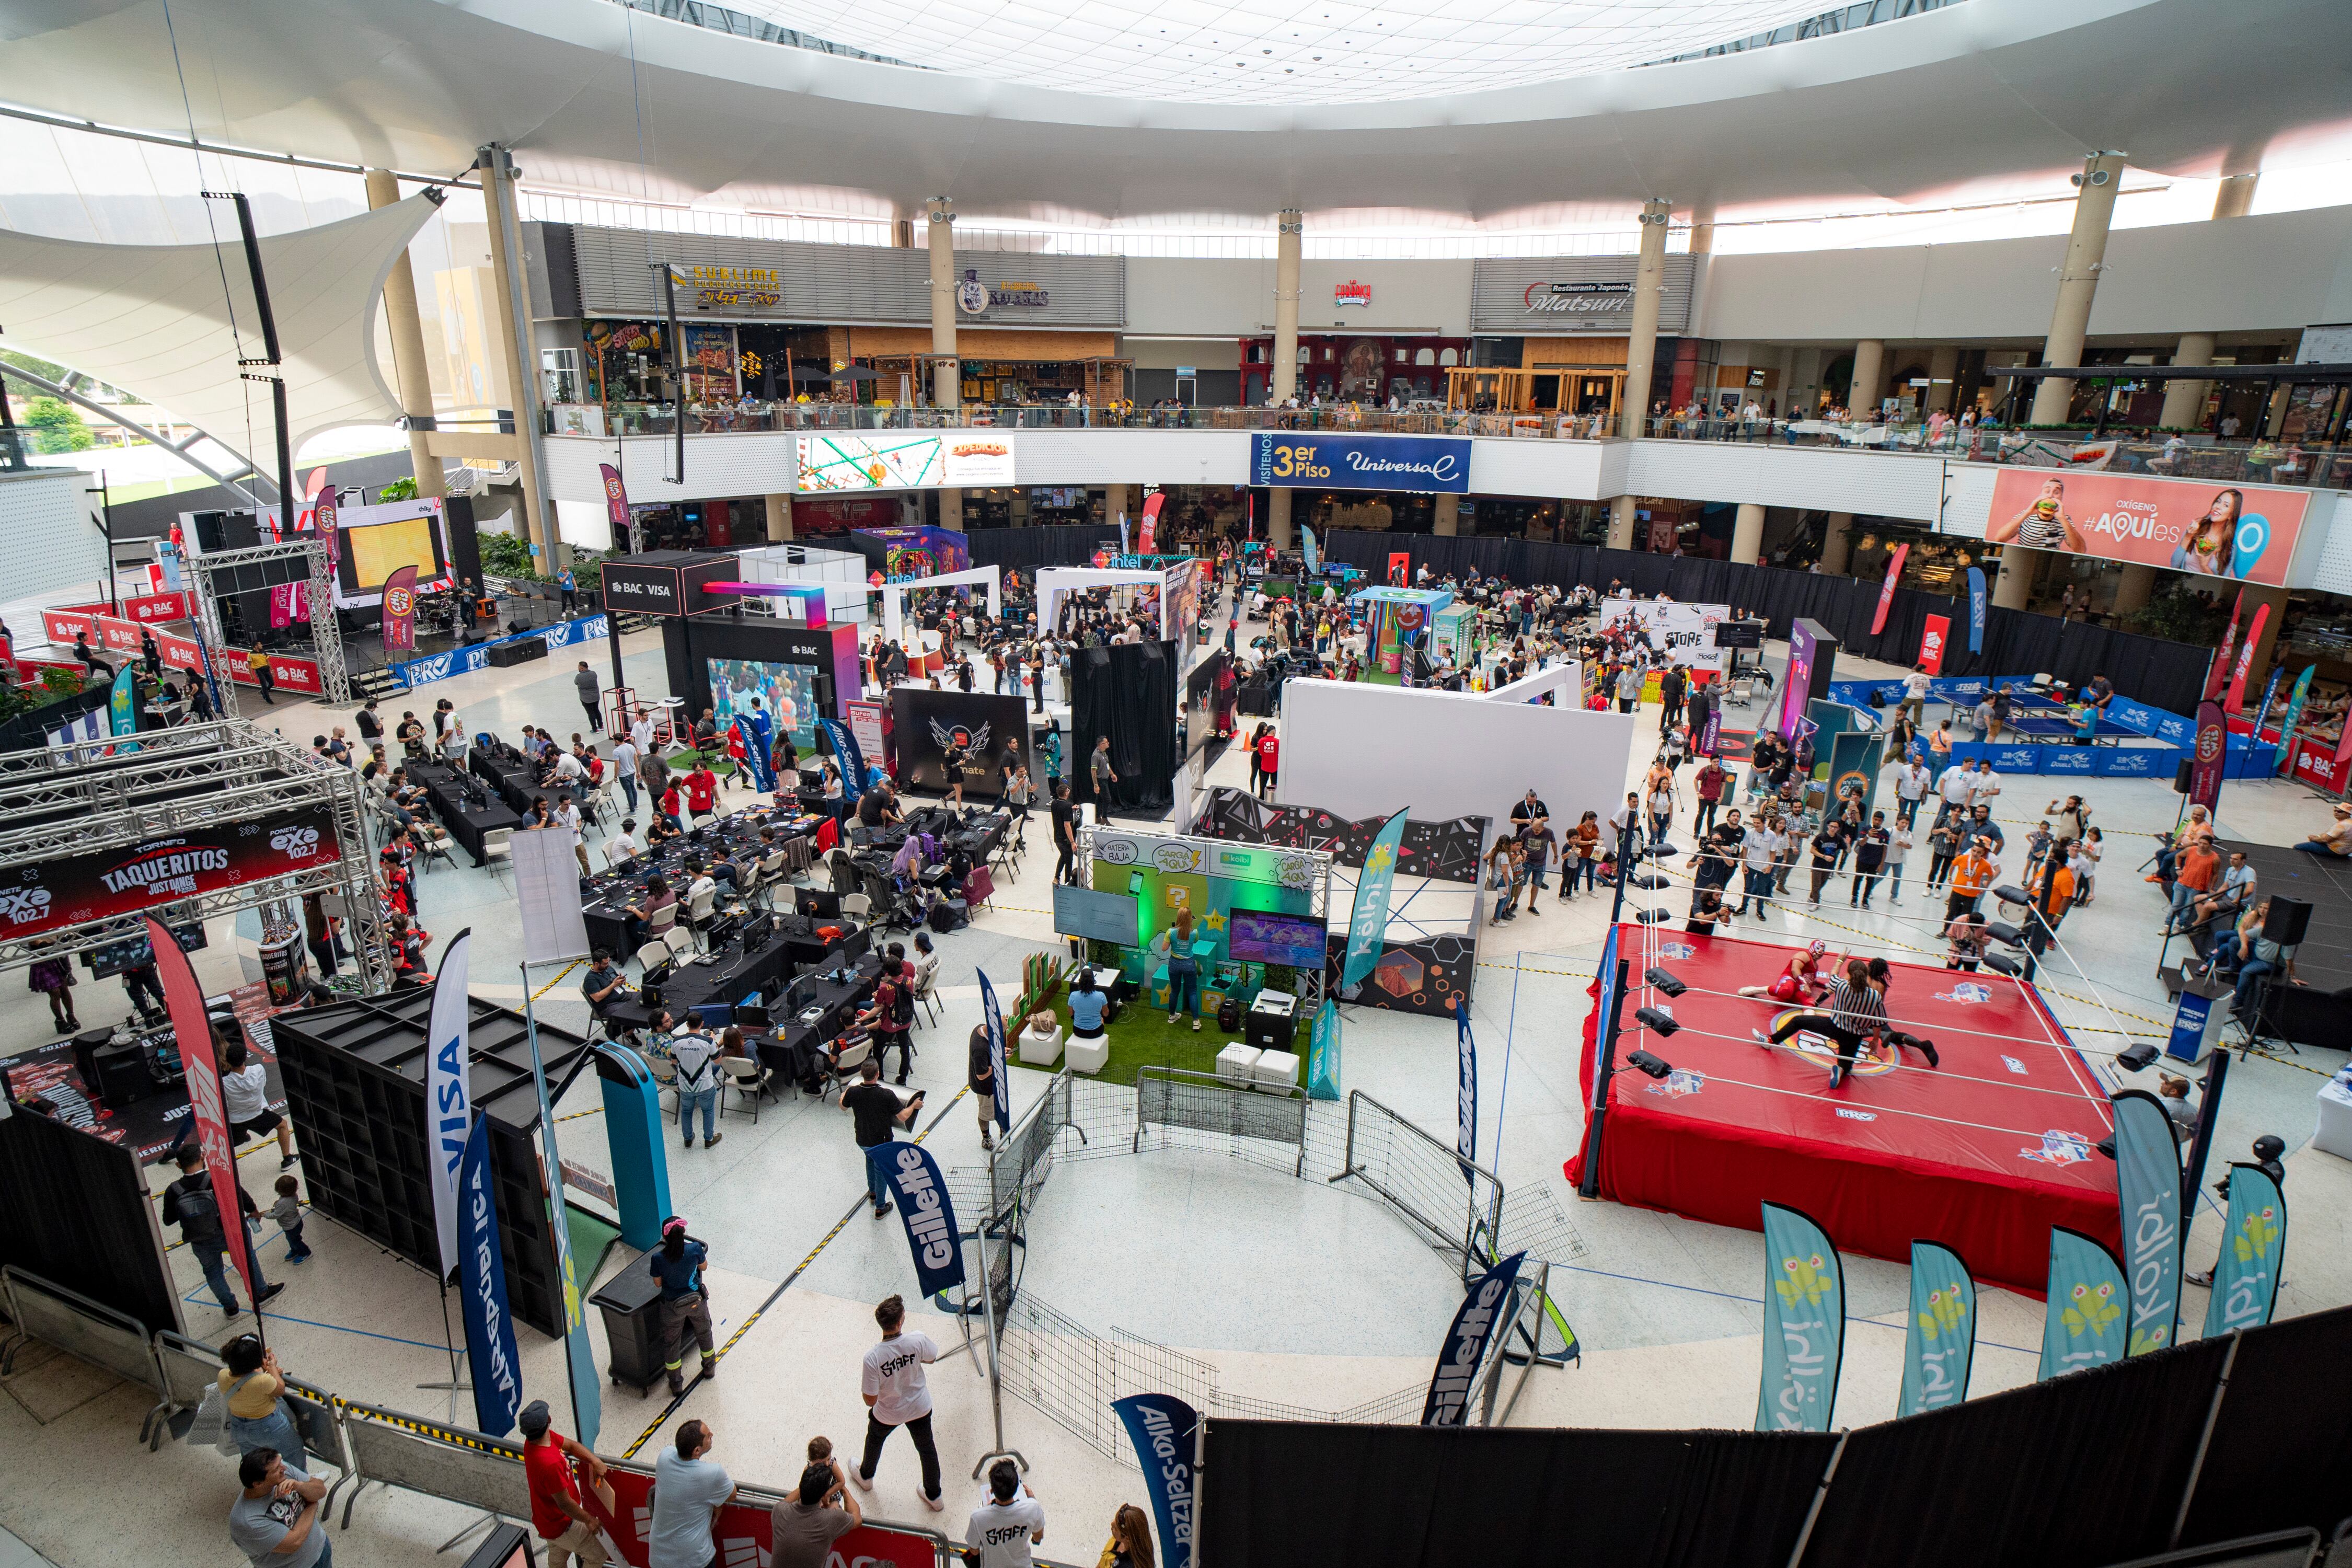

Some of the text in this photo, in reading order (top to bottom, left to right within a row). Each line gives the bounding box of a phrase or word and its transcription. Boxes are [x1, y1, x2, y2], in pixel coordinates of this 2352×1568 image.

[694, 266, 778, 282] SUBLIME
[694, 280, 742, 289] BURGERS
[696, 289, 781, 307] STREET FOOD
[1525, 293, 1632, 314] Matsuri
[951, 442, 1008, 457] EXPEDICIÓN
[1260, 433, 1272, 486] VISÍTENOS
[1346, 452, 1459, 481] Universal
[1295, 463, 1331, 478] Piso
[2116, 499, 2157, 512] OXÍGENO
[1111, 555, 1142, 569] intel
[886, 571, 915, 585] intel
[624, 583, 671, 596] BAC VISA
[153, 602, 173, 612] BAC
[119, 630, 134, 642] BAC
[1666, 631, 1702, 648] STORE
[180, 649, 194, 661] BAC
[801, 646, 817, 654] BAC
[1923, 648, 1938, 658] BAC
[231, 659, 249, 671] BAC
[406, 653, 453, 686] PRO
[290, 667, 308, 680] BAC
[850, 710, 871, 718] Bufea
[1706, 718, 1719, 752] Telecable
[740, 718, 765, 779] Alka-Seltzer
[829, 722, 858, 788] Alka-Seltzer
[270, 826, 297, 836] PONETE
[134, 838, 186, 854] TORNEO
[287, 843, 317, 859] 102.7
[1109, 852, 1131, 862] BAJA
[1230, 855, 1250, 864] kölbi
[100, 849, 228, 894] TAQUERITOS
[148, 874, 195, 895] JUST DANCE
[10, 905, 50, 925] 102.7
[1352, 882, 1384, 958] kölbi
[2177, 1018, 2203, 1031] PRO
[986, 989, 1007, 1113] Gillette
[1459, 1026, 1473, 1159] Gillette
[438, 1034, 467, 1192] VISA
[1836, 1108, 1877, 1120] PRO
[896, 1147, 952, 1270] Gillette
[880, 1354, 915, 1377] STAFF
[1136, 1404, 1192, 1544] Alka-Seltzer
[986, 1525, 1027, 1545] STAFF
